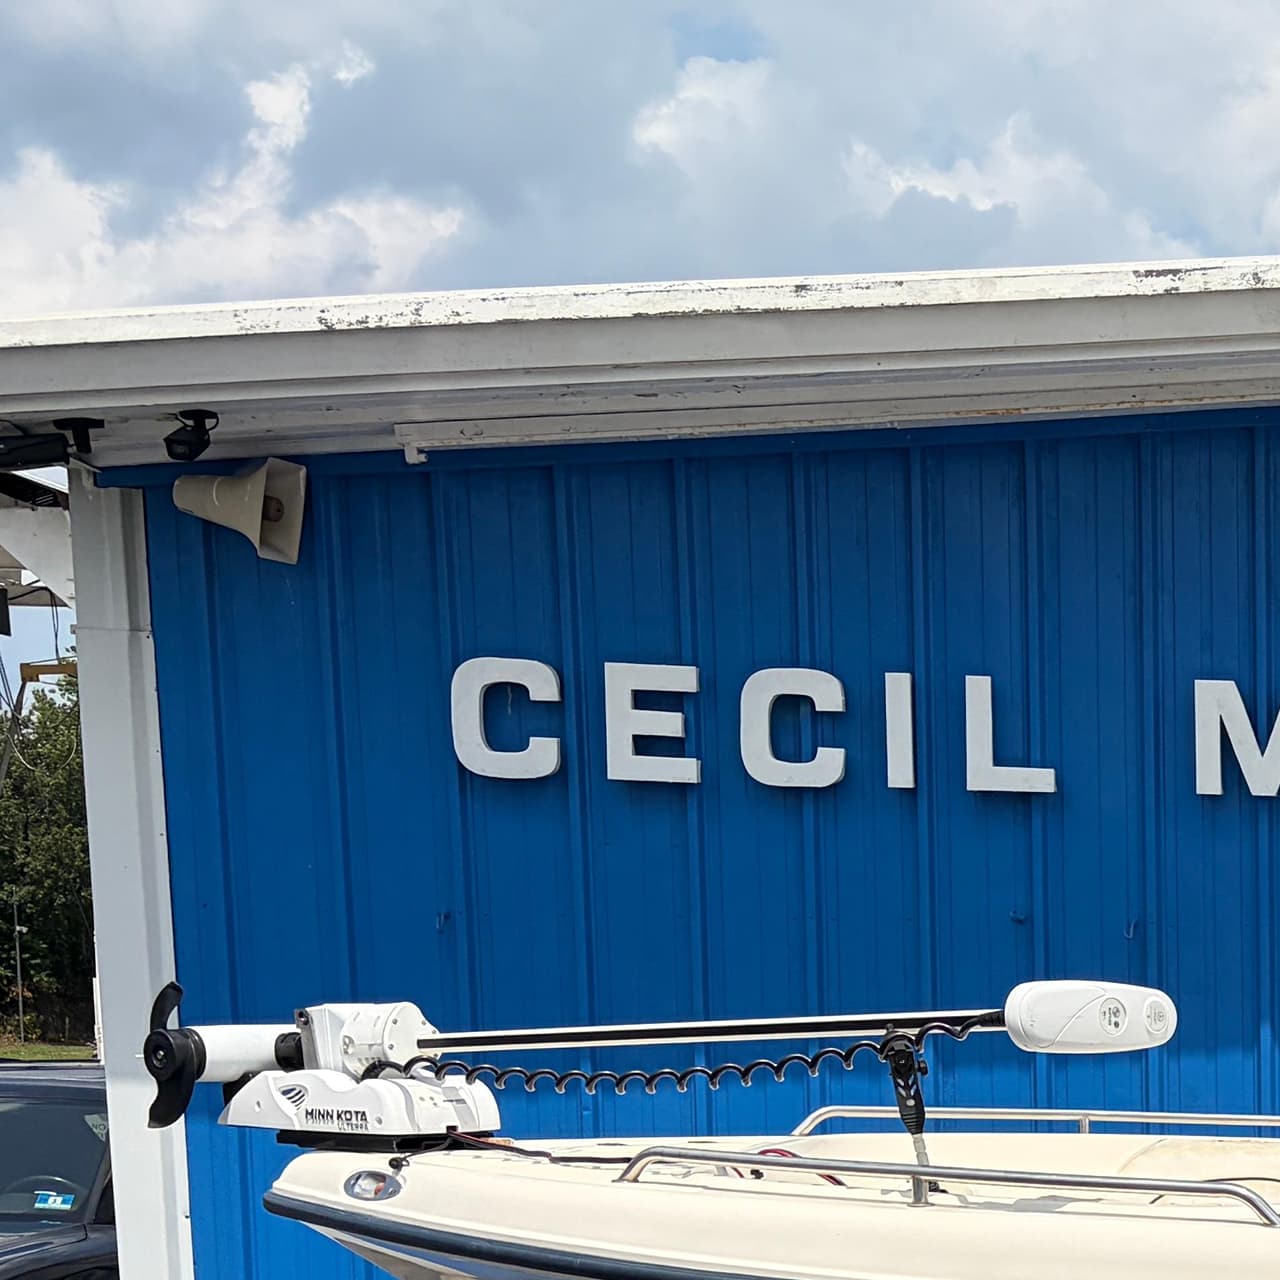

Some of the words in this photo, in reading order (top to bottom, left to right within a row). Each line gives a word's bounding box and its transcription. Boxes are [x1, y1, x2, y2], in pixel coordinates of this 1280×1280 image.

[450, 656, 1056, 793] CECIL
[305, 1108, 334, 1121] MINN
[336, 1109, 368, 1122] KOTA
